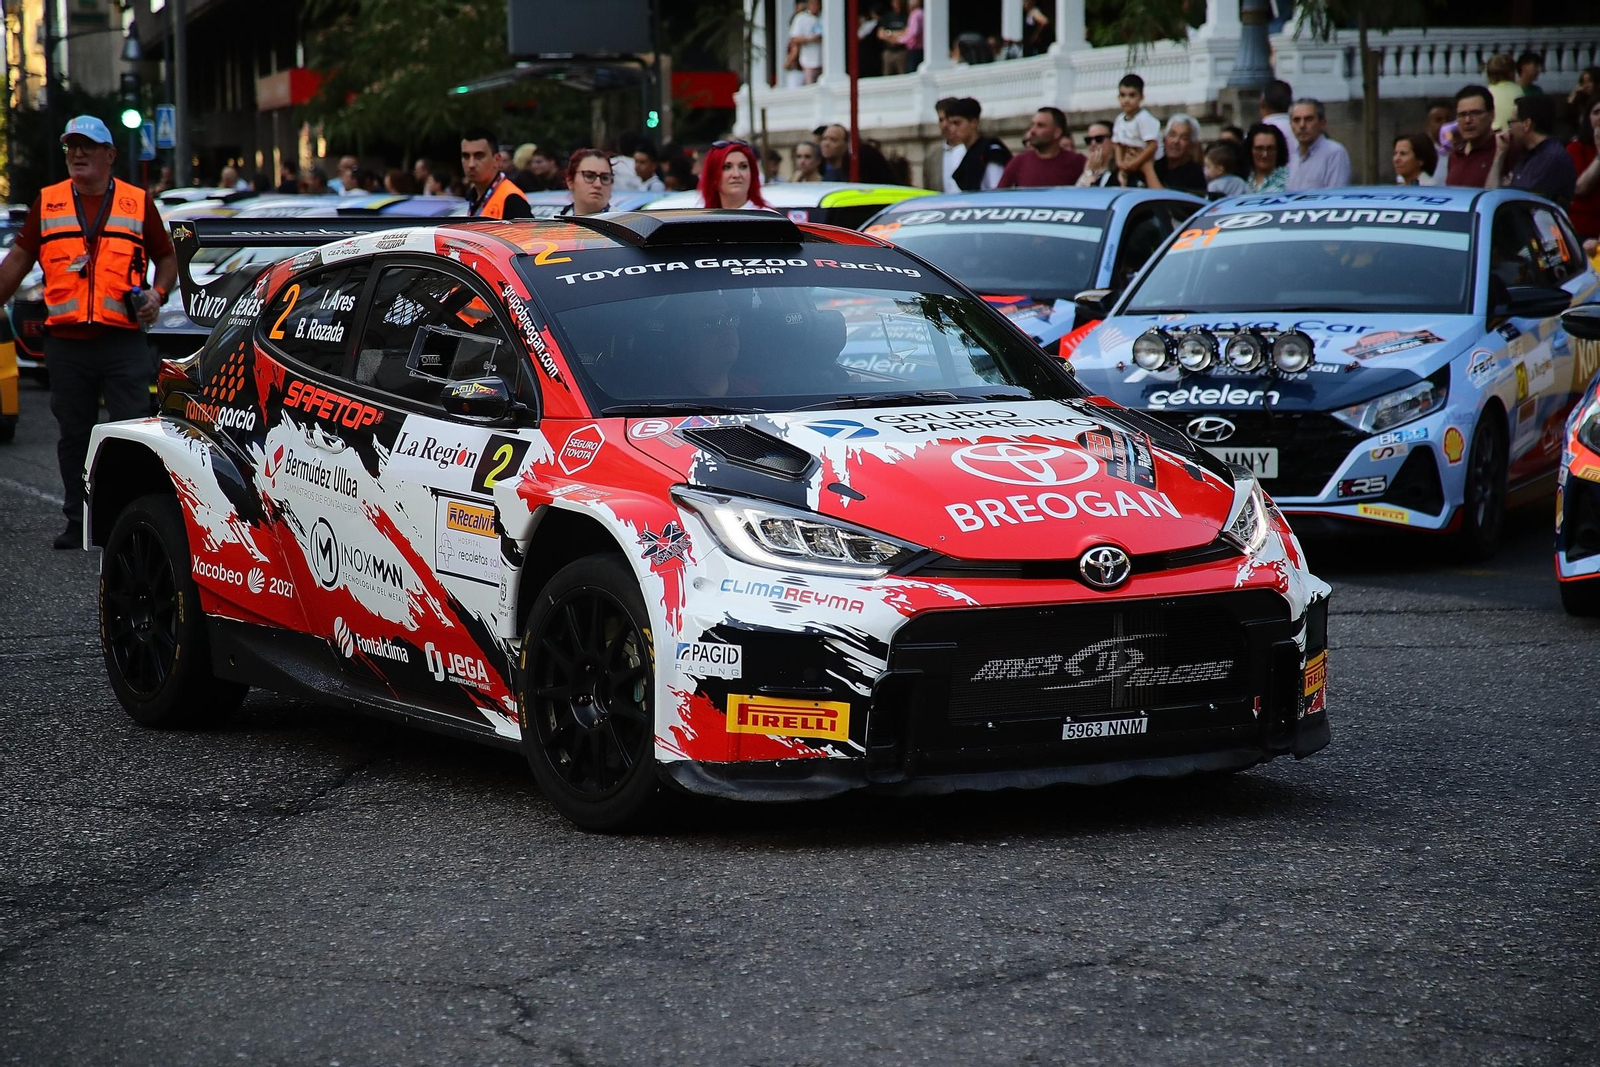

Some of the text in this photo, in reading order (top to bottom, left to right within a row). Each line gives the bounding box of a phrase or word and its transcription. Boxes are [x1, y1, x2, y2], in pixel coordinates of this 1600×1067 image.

[949, 208, 1084, 223] HYUNDAI
[1279, 209, 1440, 226] HYUNDAI
[1171, 228, 1220, 251] 21
[522, 241, 572, 266] 2
[555, 258, 922, 285] TOYOTA GAZOO Racing
[730, 266, 784, 276] Spain
[230, 295, 265, 317] texas
[269, 283, 301, 340] 2
[327, 290, 356, 312] Ares
[295, 317, 345, 343] B. Rozada
[501, 284, 560, 378] grupobreogan.com
[1147, 383, 1280, 409] cetelem
[873, 409, 1018, 424] GRUPO
[892, 417, 1096, 434] BARREIRO
[638, 423, 660, 436] E
[395, 432, 479, 470] La Región
[564, 447, 592, 460] TOYOTA
[567, 438, 599, 450] SEGURO
[284, 448, 359, 499] Bermúdez Ulloa
[483, 443, 514, 489] 2
[457, 508, 491, 531] Recalvi
[944, 490, 1183, 533] BREOGAN
[458, 537, 482, 549] HOSPITAL
[341, 541, 404, 590] INOXMAN
[458, 550, 489, 566] recoletas
[192, 554, 293, 599] Xacobeo 2027
[377, 585, 387, 597] DEL
[388, 590, 405, 605] METAL
[720, 579, 865, 614] CLIMAREYMA
[356, 633, 409, 664] Fontalclima
[691, 643, 739, 665] PAGID
[674, 663, 740, 677] RACING
[737, 703, 839, 732] PIRELLI
[1066, 718, 1144, 739] 5963 NNM
